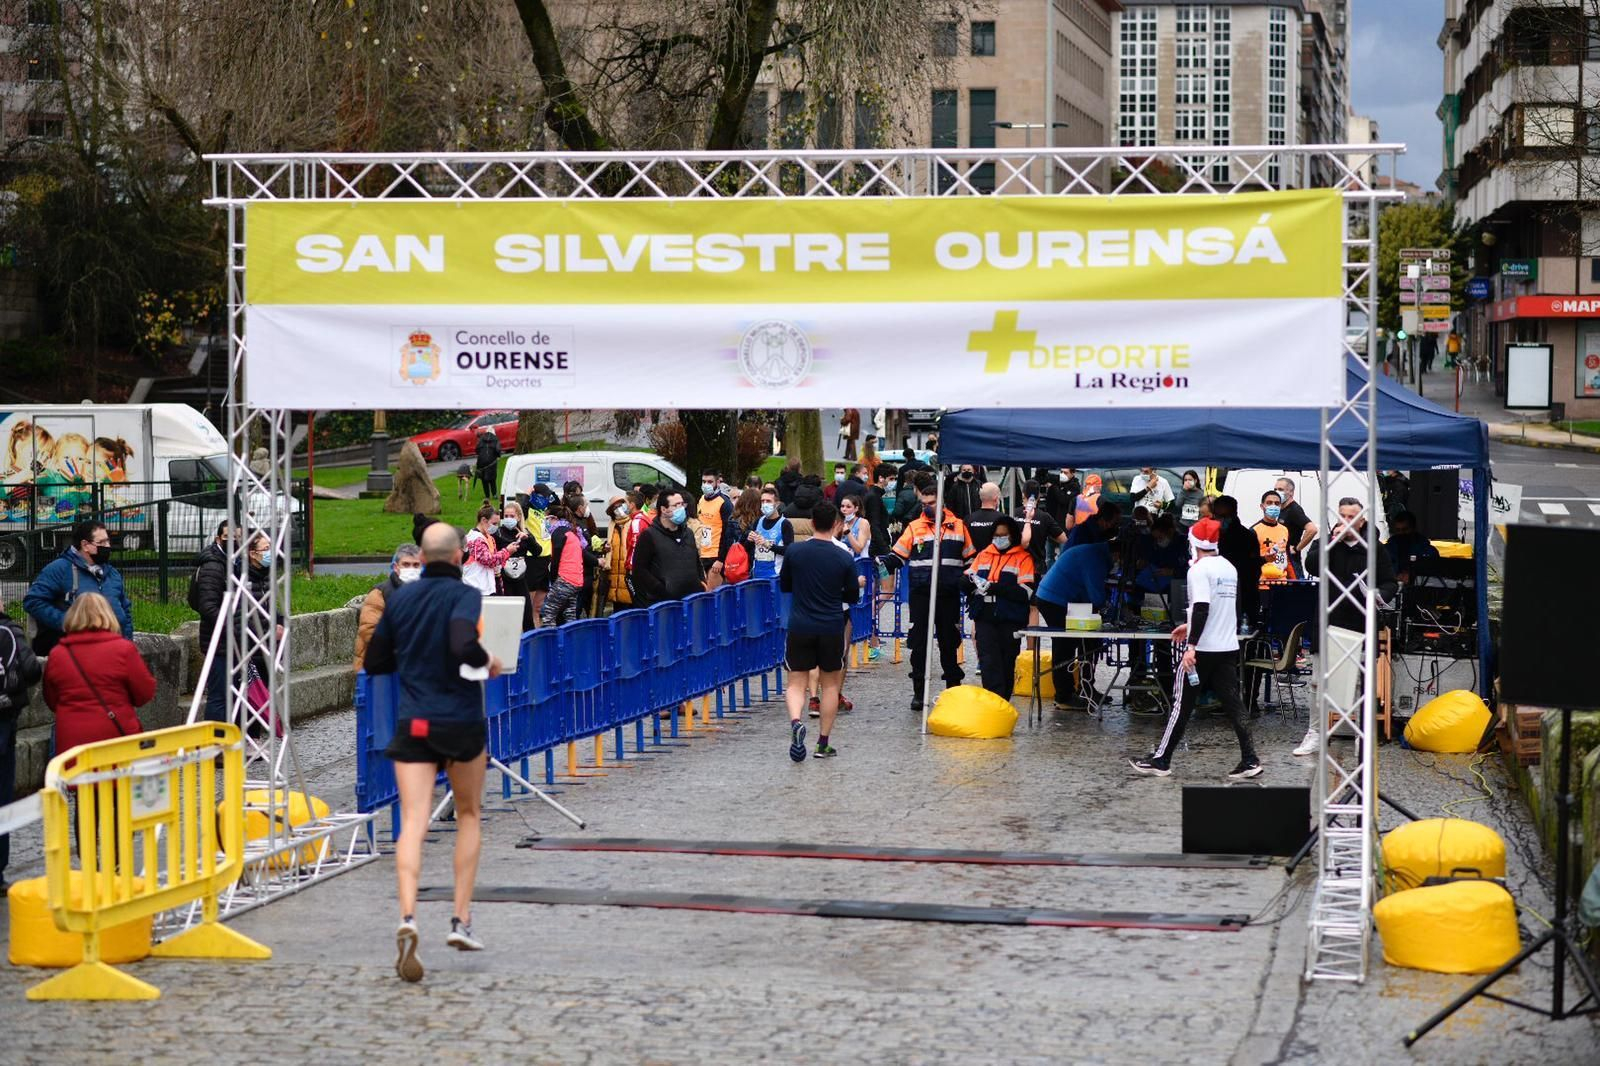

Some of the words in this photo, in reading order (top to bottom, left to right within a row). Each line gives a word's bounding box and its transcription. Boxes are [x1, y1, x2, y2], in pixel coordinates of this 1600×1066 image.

[295, 233, 446, 273] SAN
[494, 232, 891, 274] SILVESTRE
[934, 212, 1288, 271] OURENSÁ
[455, 330, 526, 345] Concello
[531, 330, 550, 345] de
[456, 351, 569, 370] OURENSE
[486, 375, 542, 389] Deportes
[1075, 373, 1104, 389] La
